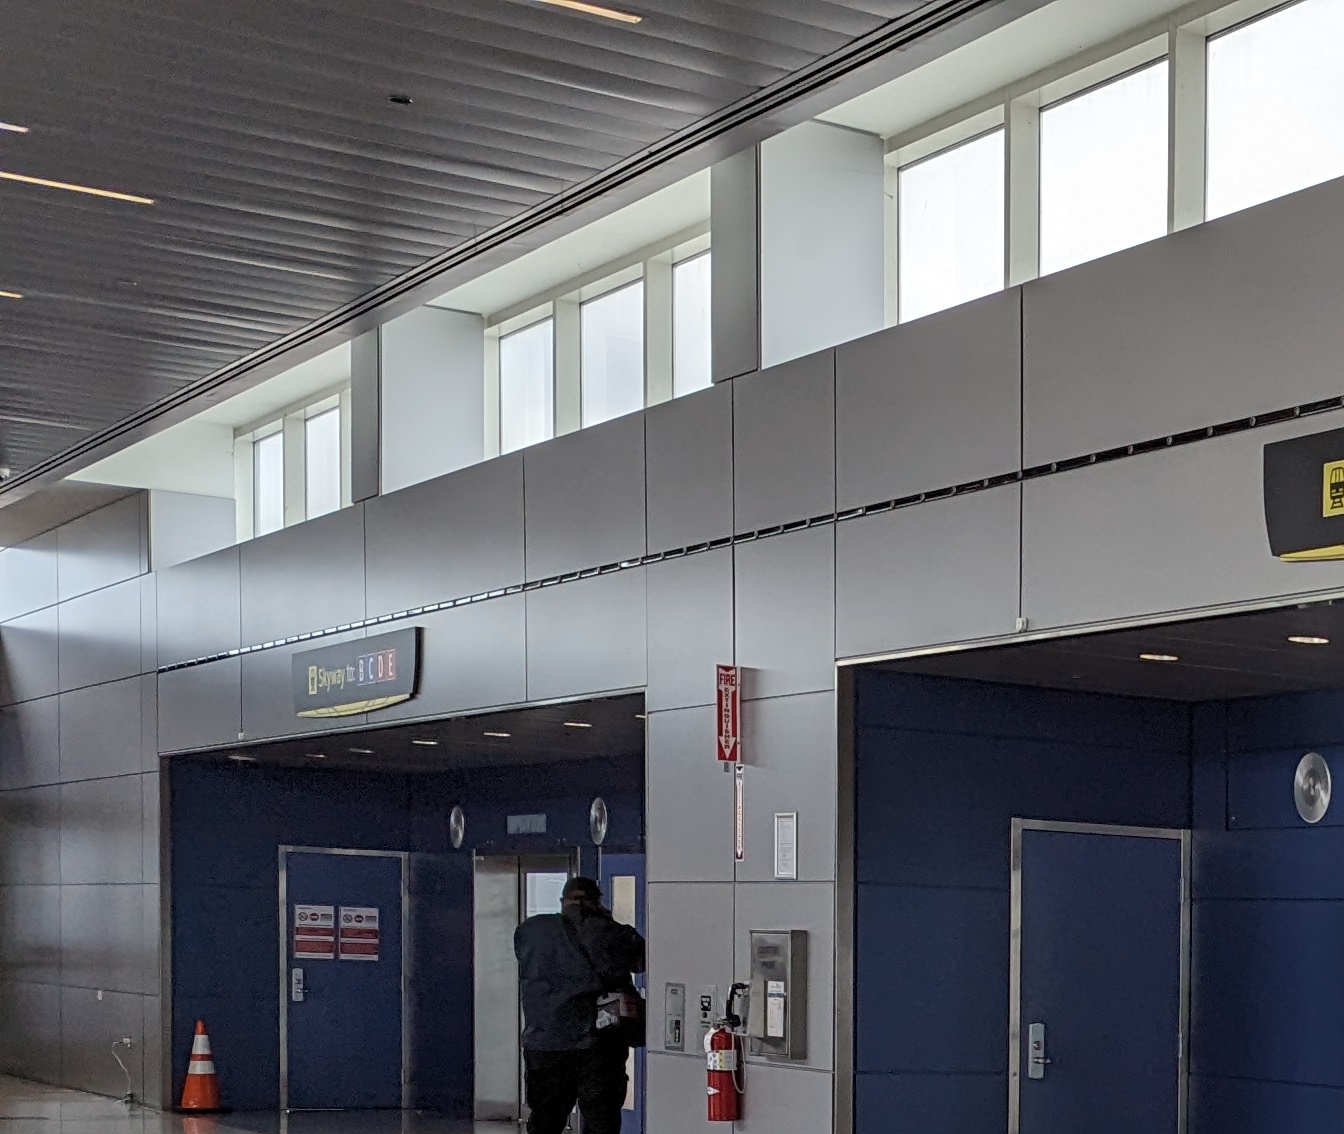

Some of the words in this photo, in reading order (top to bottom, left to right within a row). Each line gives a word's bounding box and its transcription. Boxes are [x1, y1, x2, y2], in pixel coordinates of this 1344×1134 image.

[318, 667, 346, 692] Skyway
[719, 673, 736, 686] FIRE
[723, 687, 731, 750] EXTINGUISHER
